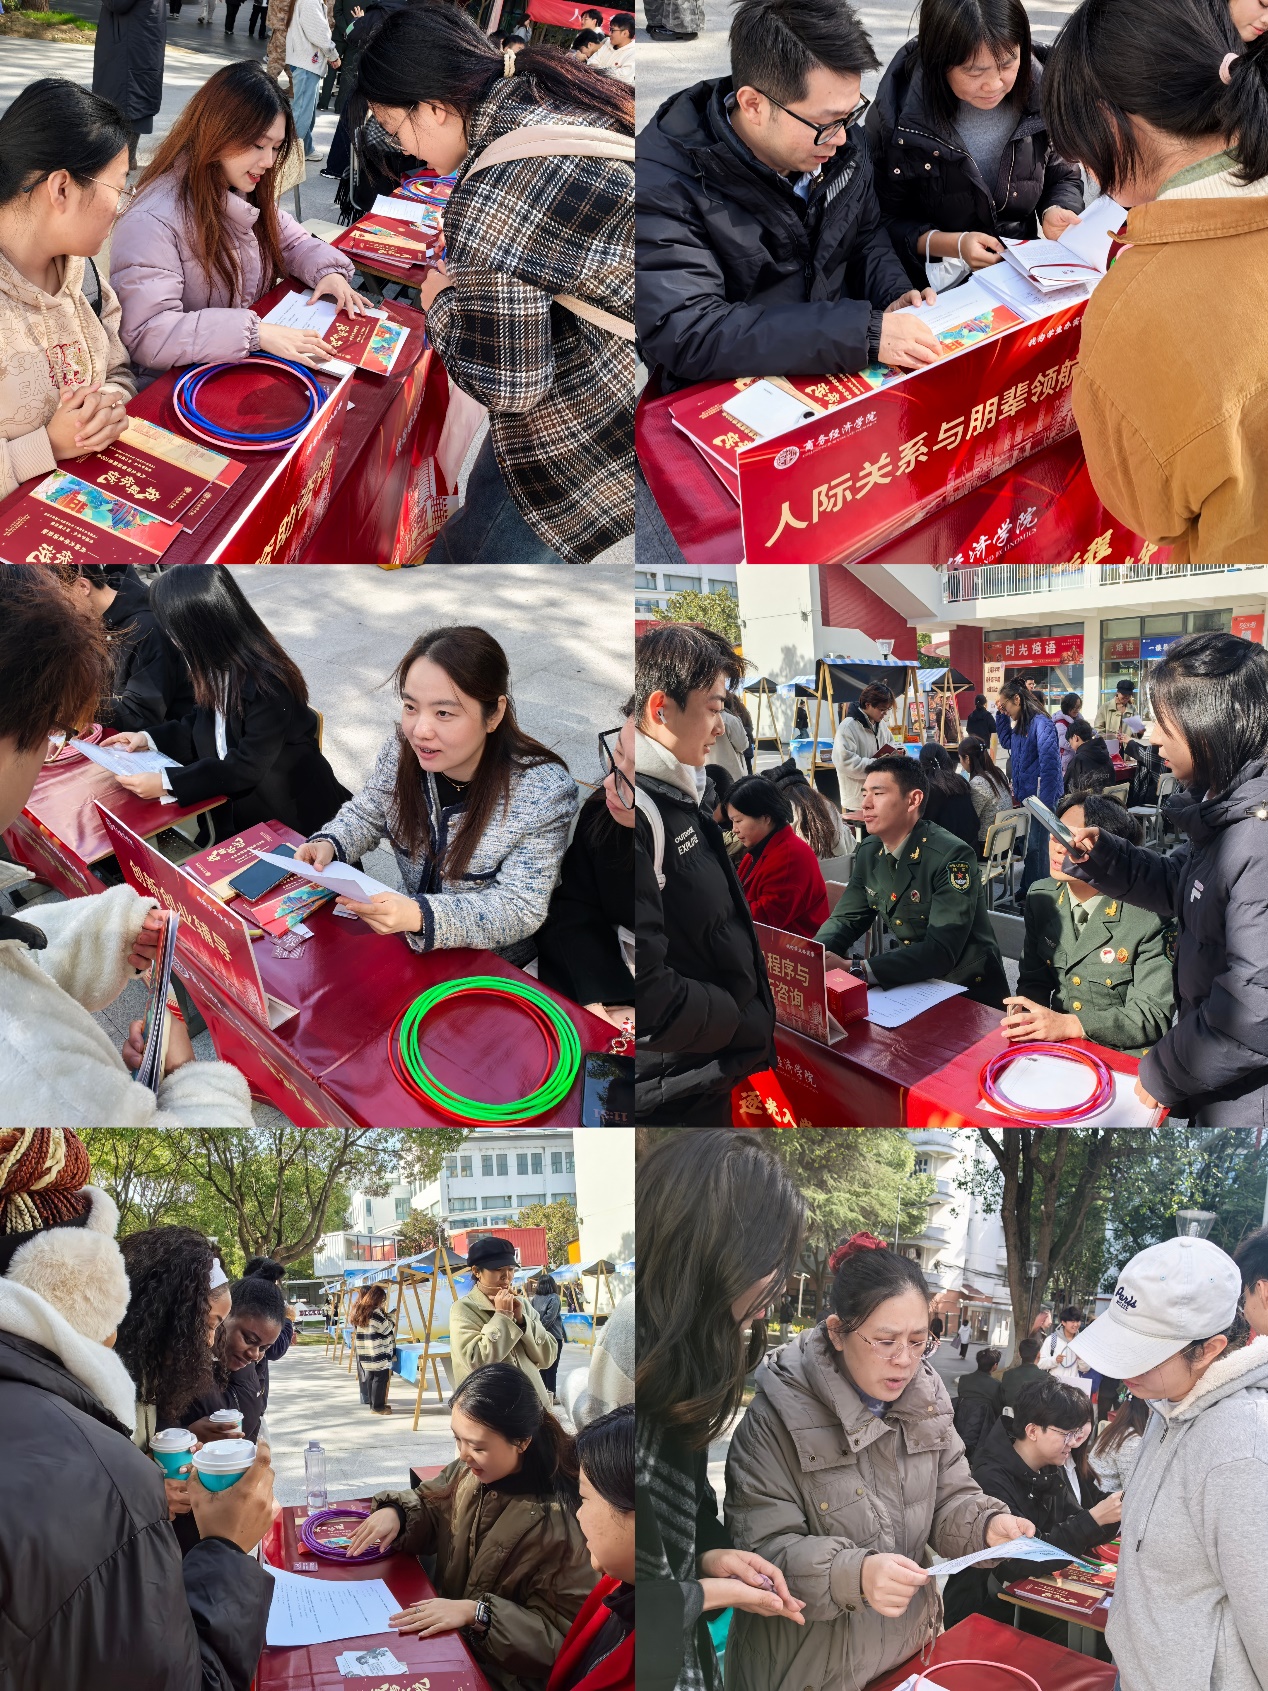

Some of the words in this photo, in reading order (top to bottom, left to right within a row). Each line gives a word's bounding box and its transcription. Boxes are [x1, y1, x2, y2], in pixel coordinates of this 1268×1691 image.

[802, 410, 878, 452] 商务经济学院
[1005, 640, 1057, 656] 时光焙语
[761, 950, 810, 987] 程序与
[1114, 1286, 1137, 1309] Paris
